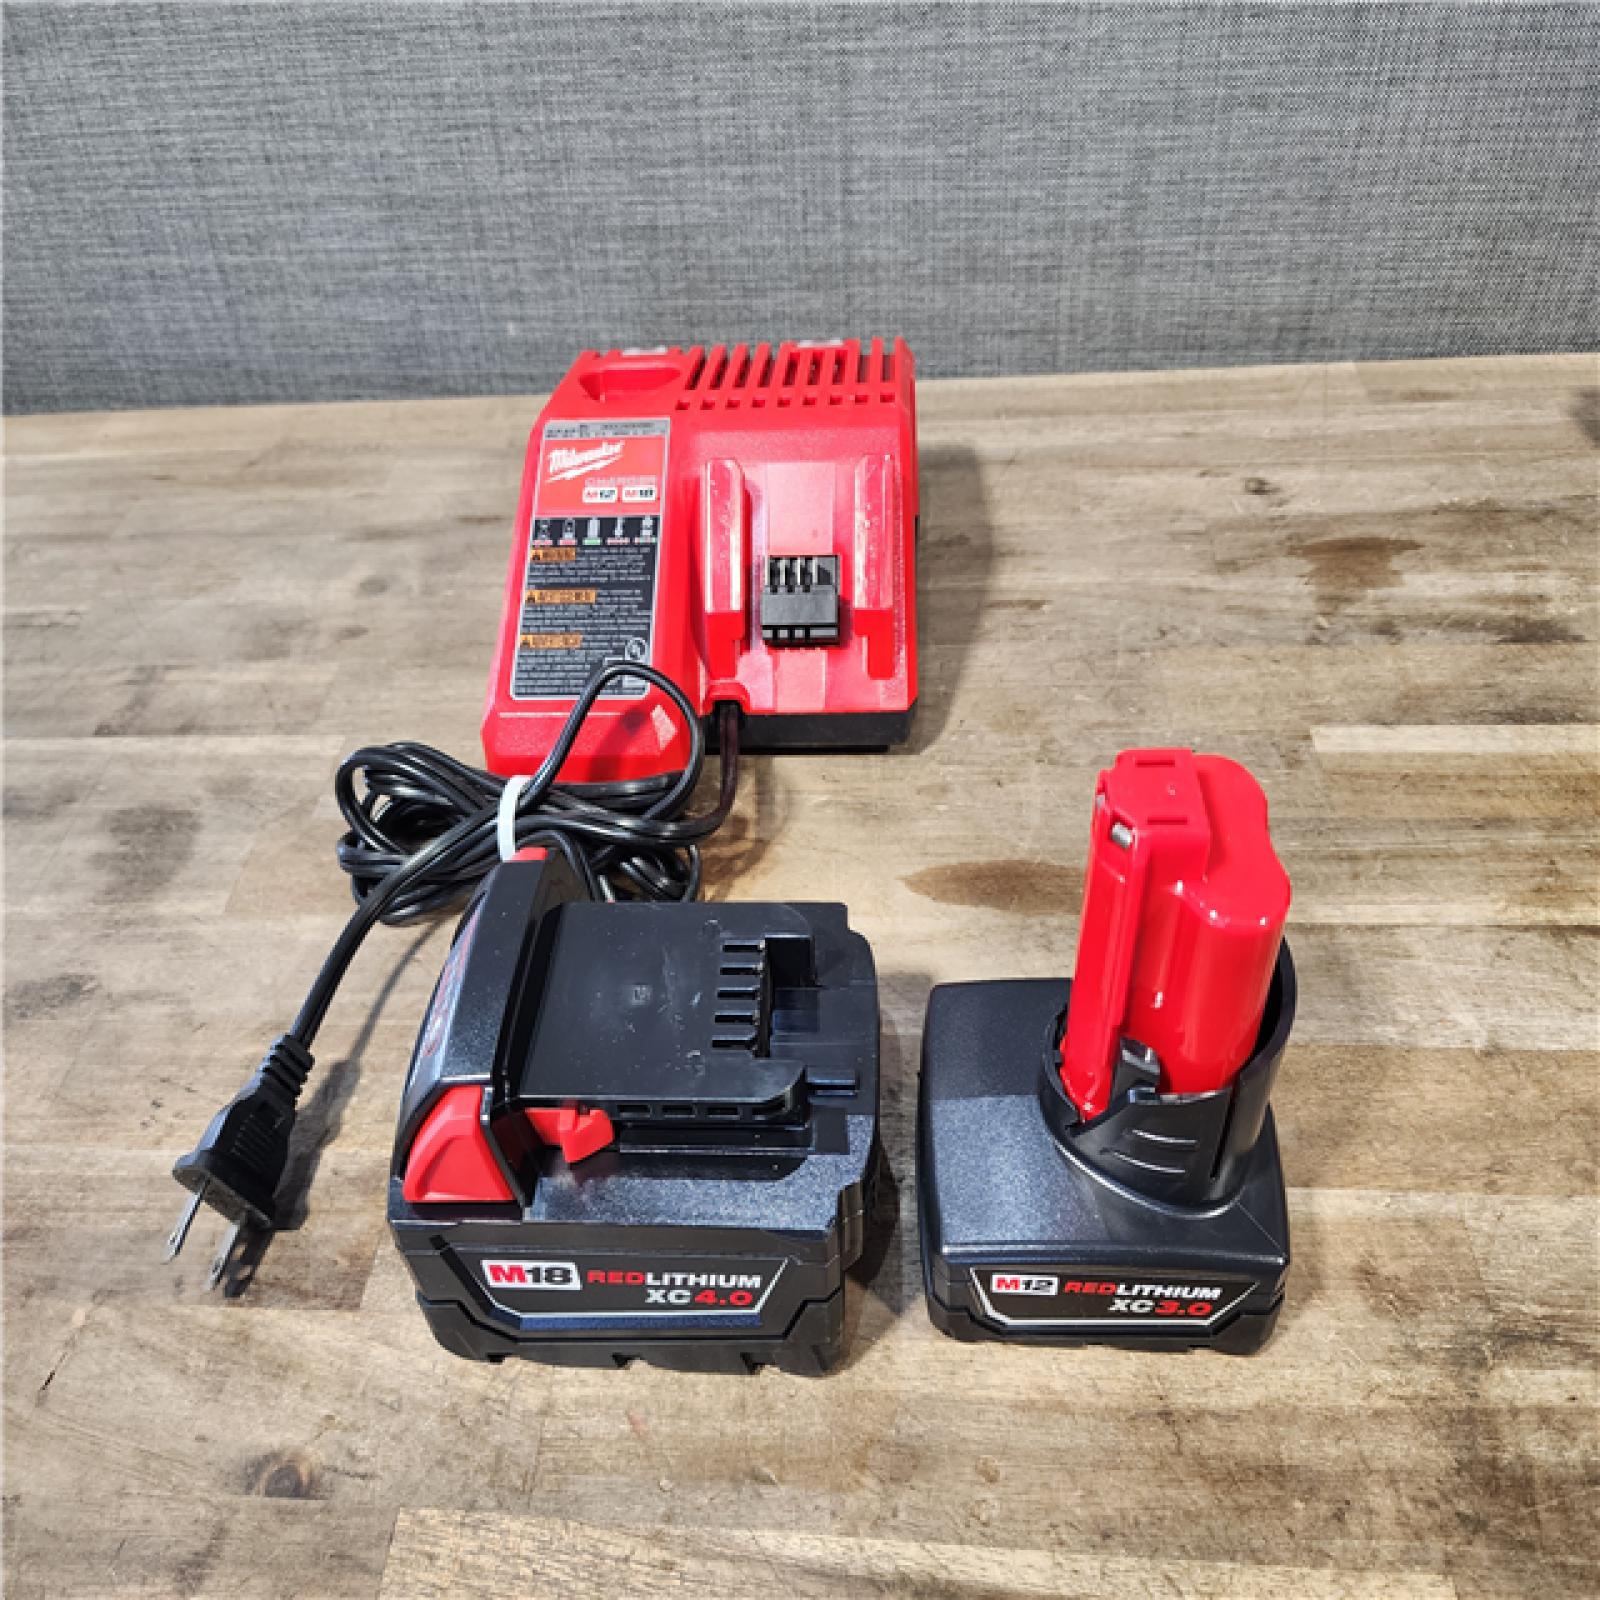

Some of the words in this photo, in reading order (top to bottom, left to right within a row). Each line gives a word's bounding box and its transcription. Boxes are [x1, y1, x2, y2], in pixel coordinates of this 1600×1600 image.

[487, 1264, 573, 1284] M18
[587, 1270, 761, 1288] REDLITHIUM
[996, 1276, 1054, 1291] M12
[1064, 1281, 1222, 1300] REDLITHIUM
